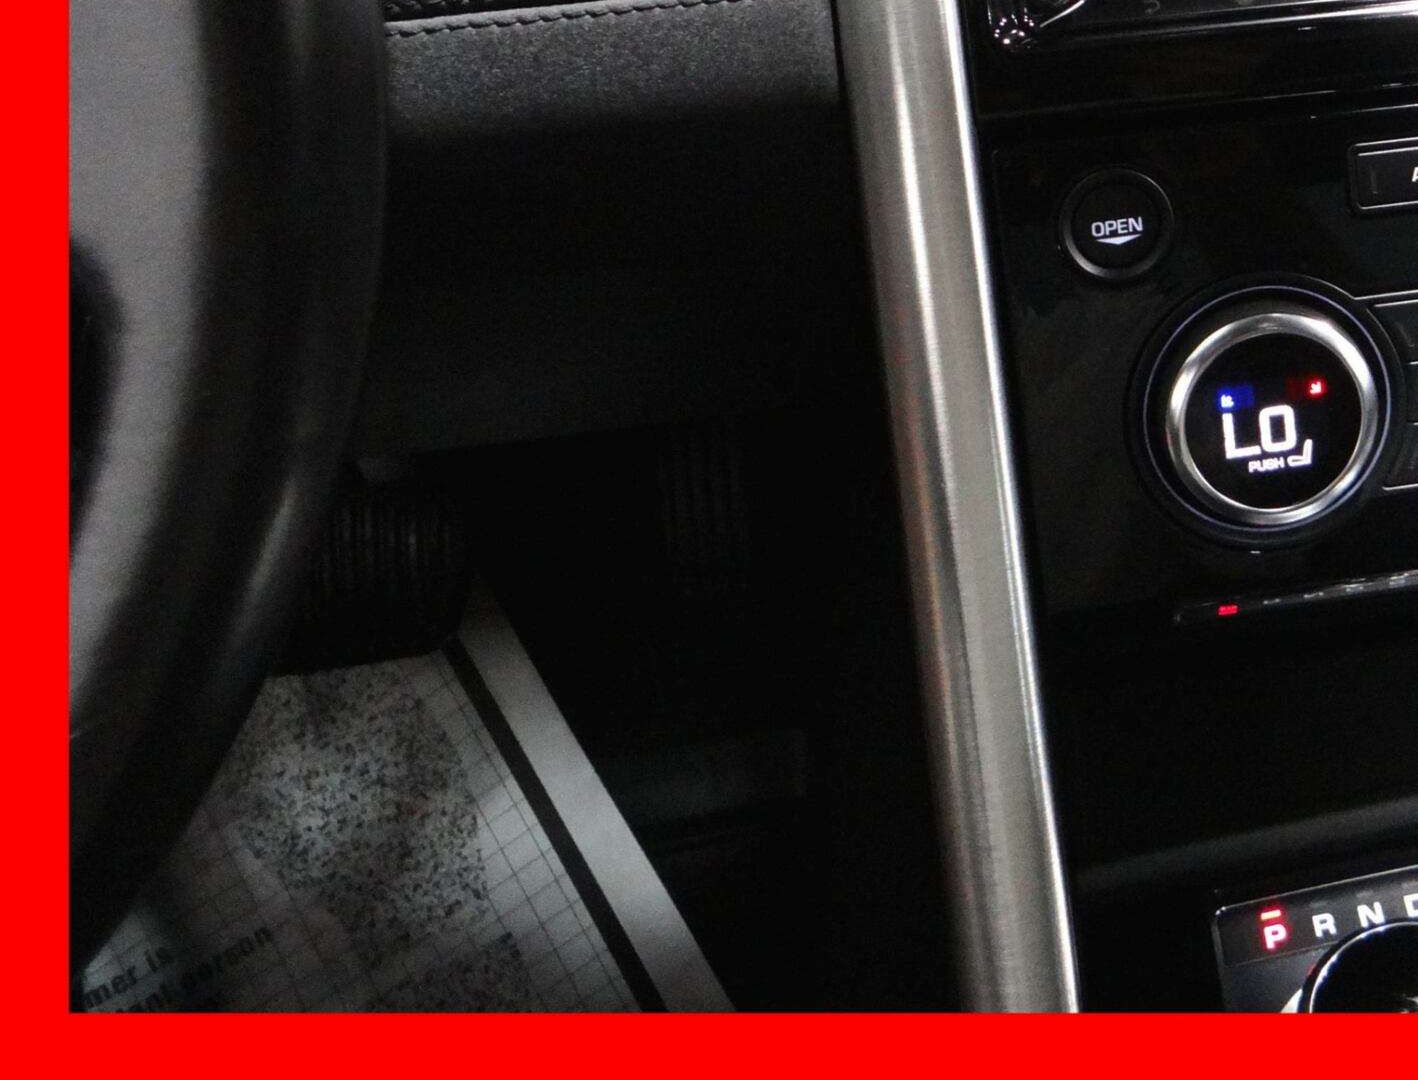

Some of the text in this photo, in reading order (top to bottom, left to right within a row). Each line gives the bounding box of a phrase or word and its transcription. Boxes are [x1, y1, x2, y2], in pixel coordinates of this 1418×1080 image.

[1091, 217, 1143, 238] OPEN
[1222, 404, 1298, 459] LO
[1248, 456, 1285, 473] PUSH
[1263, 925, 1287, 949] P
[1312, 913, 1337, 938] R
[1357, 902, 1386, 927] N
